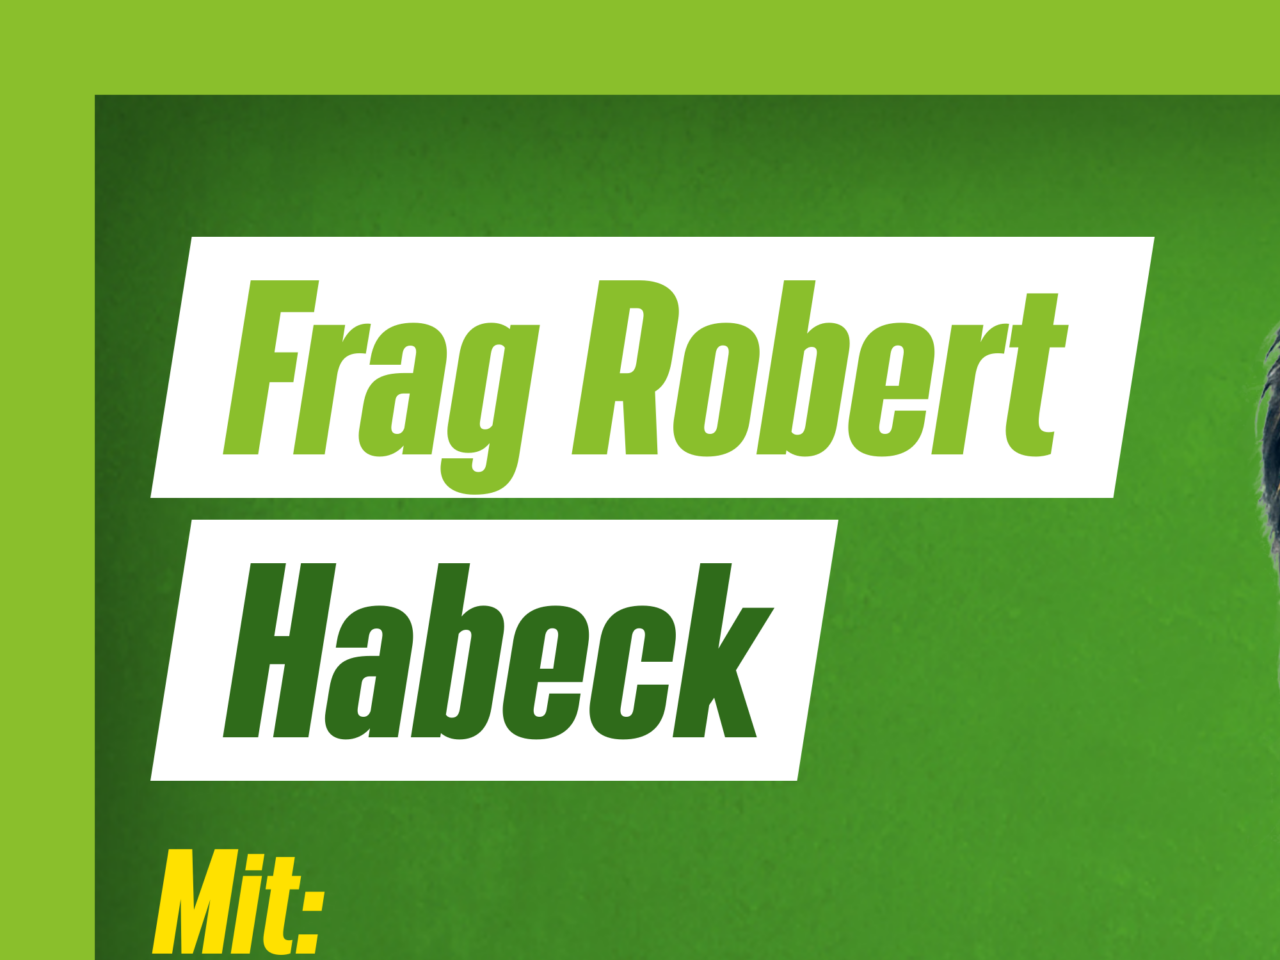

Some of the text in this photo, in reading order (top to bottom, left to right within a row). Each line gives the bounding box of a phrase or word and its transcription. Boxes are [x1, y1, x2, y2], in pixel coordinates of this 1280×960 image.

[222, 279, 1069, 494] Frag Robert
[222, 562, 775, 740] Habeck
[151, 848, 325, 955] Mit:
